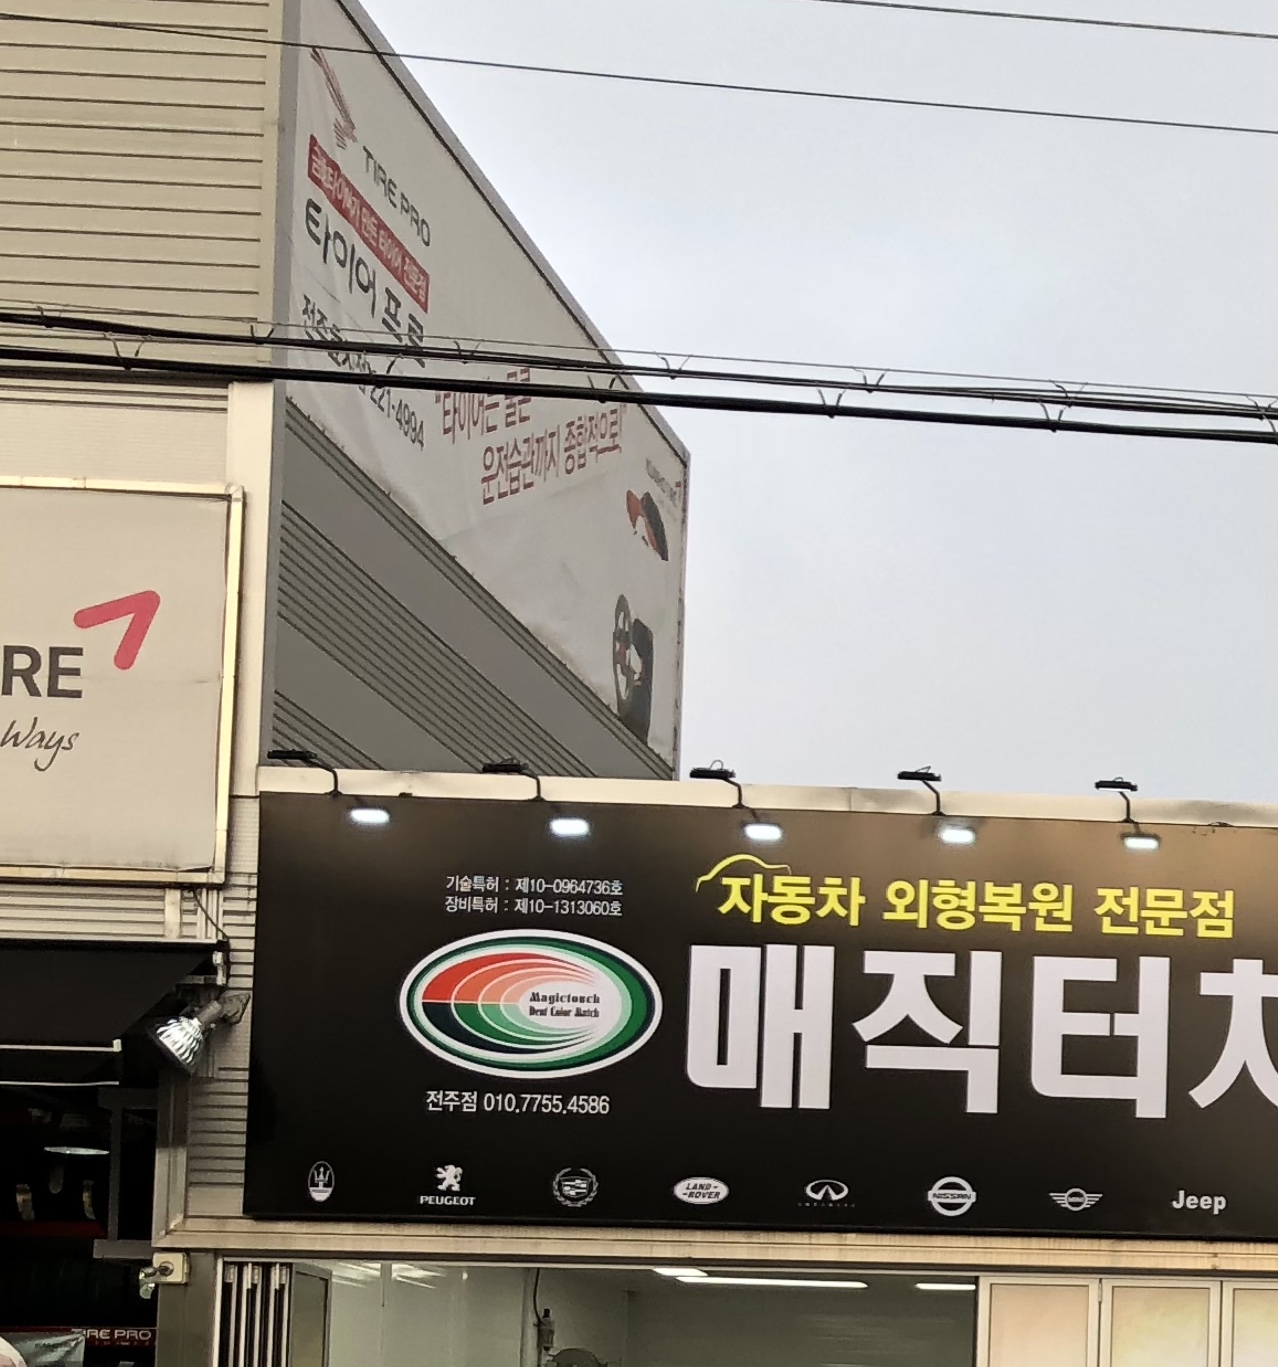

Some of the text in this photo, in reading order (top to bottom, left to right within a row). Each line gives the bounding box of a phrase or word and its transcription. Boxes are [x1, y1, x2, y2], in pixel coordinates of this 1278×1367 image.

[363, 145, 430, 247] TIRE PRO
[305, 198, 376, 319] 타이어
[481, 424, 561, 505] 운전습관까지
[0, 717, 80, 771] Ways
[446, 875, 624, 896] 기술특허 제10-0964736호
[445, 895, 623, 916] 장비특허 제10-1313060호
[718, 873, 1236, 939] 자동차 외형복원 전문점
[425, 1090, 611, 1115] 전주점 010.7755.4586
[419, 1195, 477, 1206] PEUGEOT
[1172, 1190, 1227, 1215] Jeep
[114, 1328, 152, 1340] PRO
